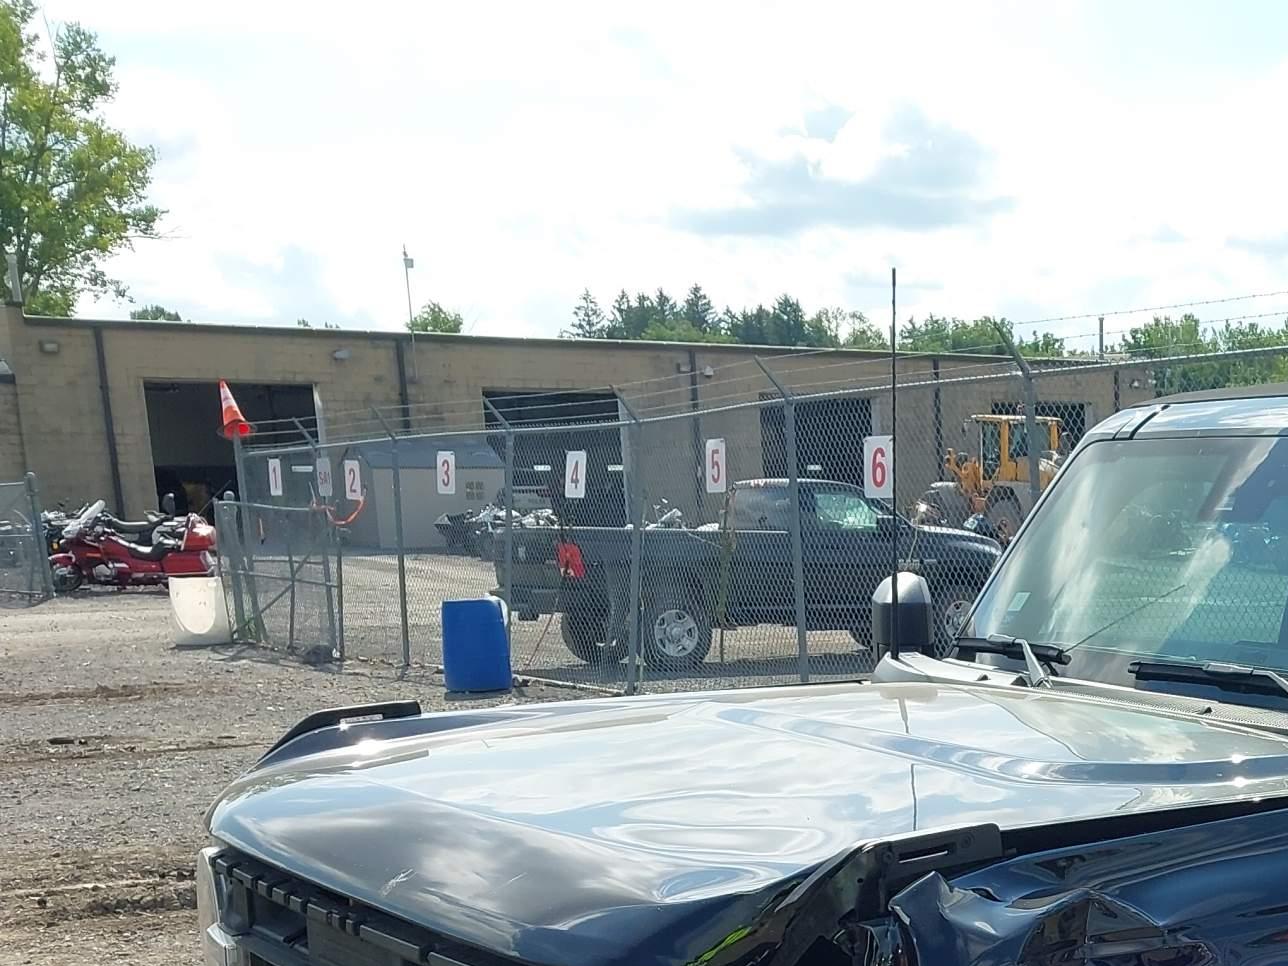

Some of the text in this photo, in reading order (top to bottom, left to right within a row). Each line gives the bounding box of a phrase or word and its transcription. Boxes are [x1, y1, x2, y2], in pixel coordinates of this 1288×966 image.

[272, 466, 278, 489] 1
[348, 468, 357, 493] 2
[441, 459, 450, 487] 3
[570, 460, 579, 489] 4
[711, 449, 720, 484] 5
[872, 447, 886, 488] 6
